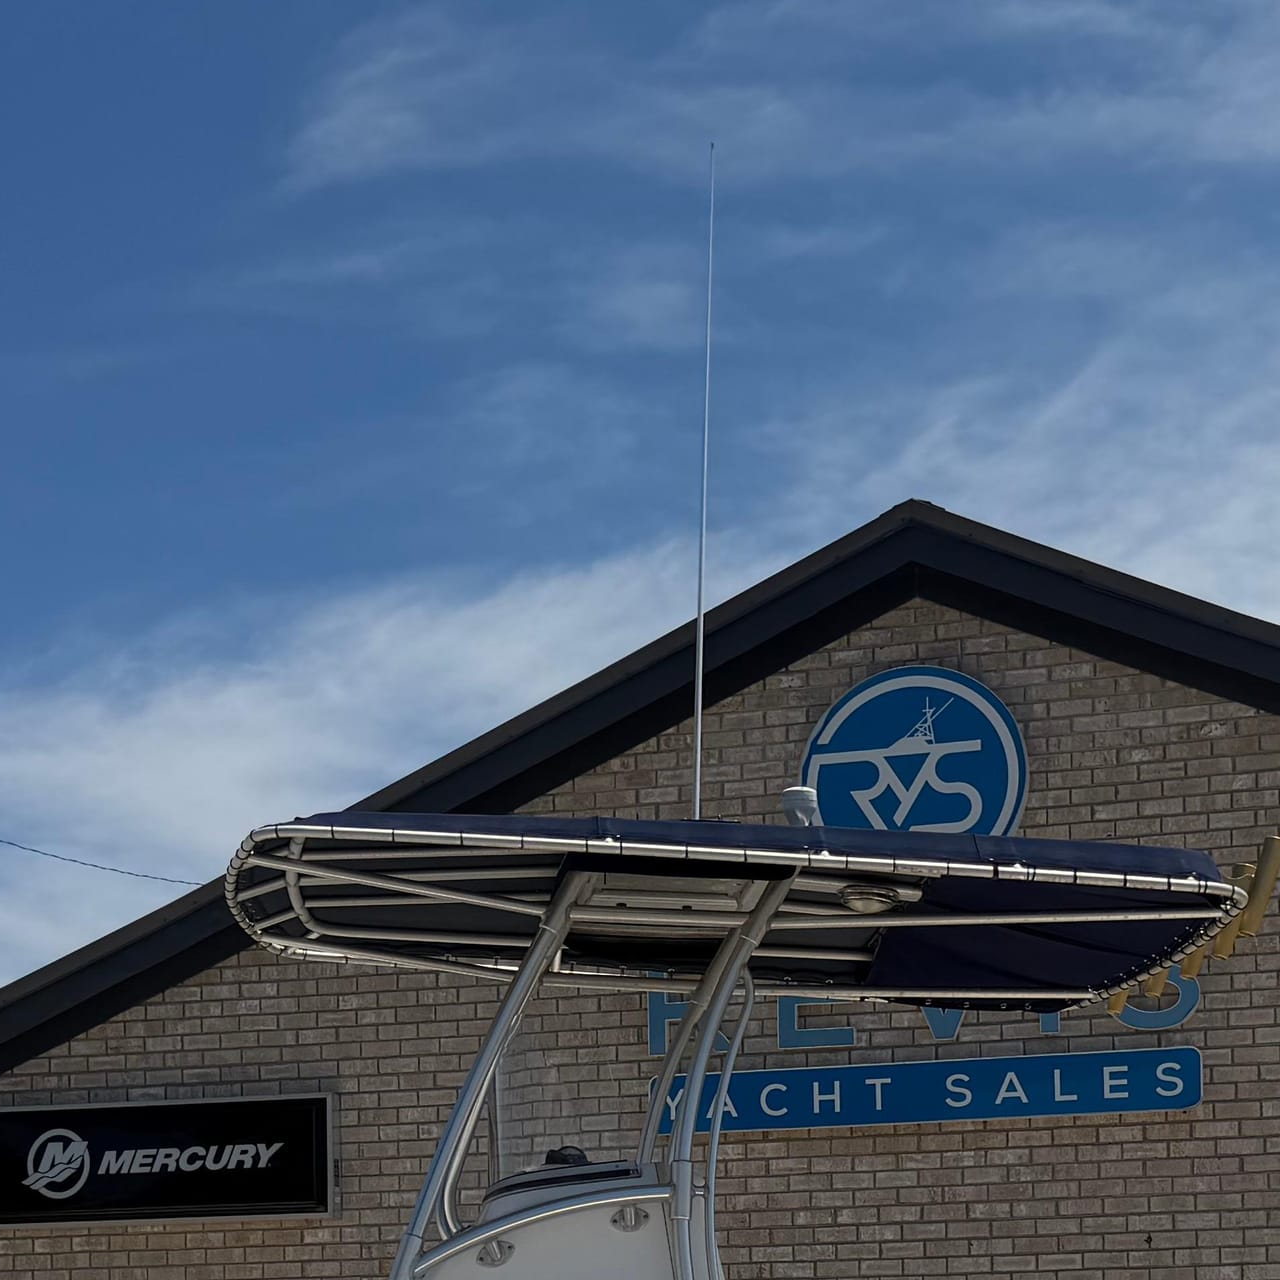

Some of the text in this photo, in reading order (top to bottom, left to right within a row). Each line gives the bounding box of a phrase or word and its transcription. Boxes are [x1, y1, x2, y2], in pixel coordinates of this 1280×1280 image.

[665, 1062, 1185, 1121] YACHT SALES
[97, 1142, 285, 1176] MERCURY
